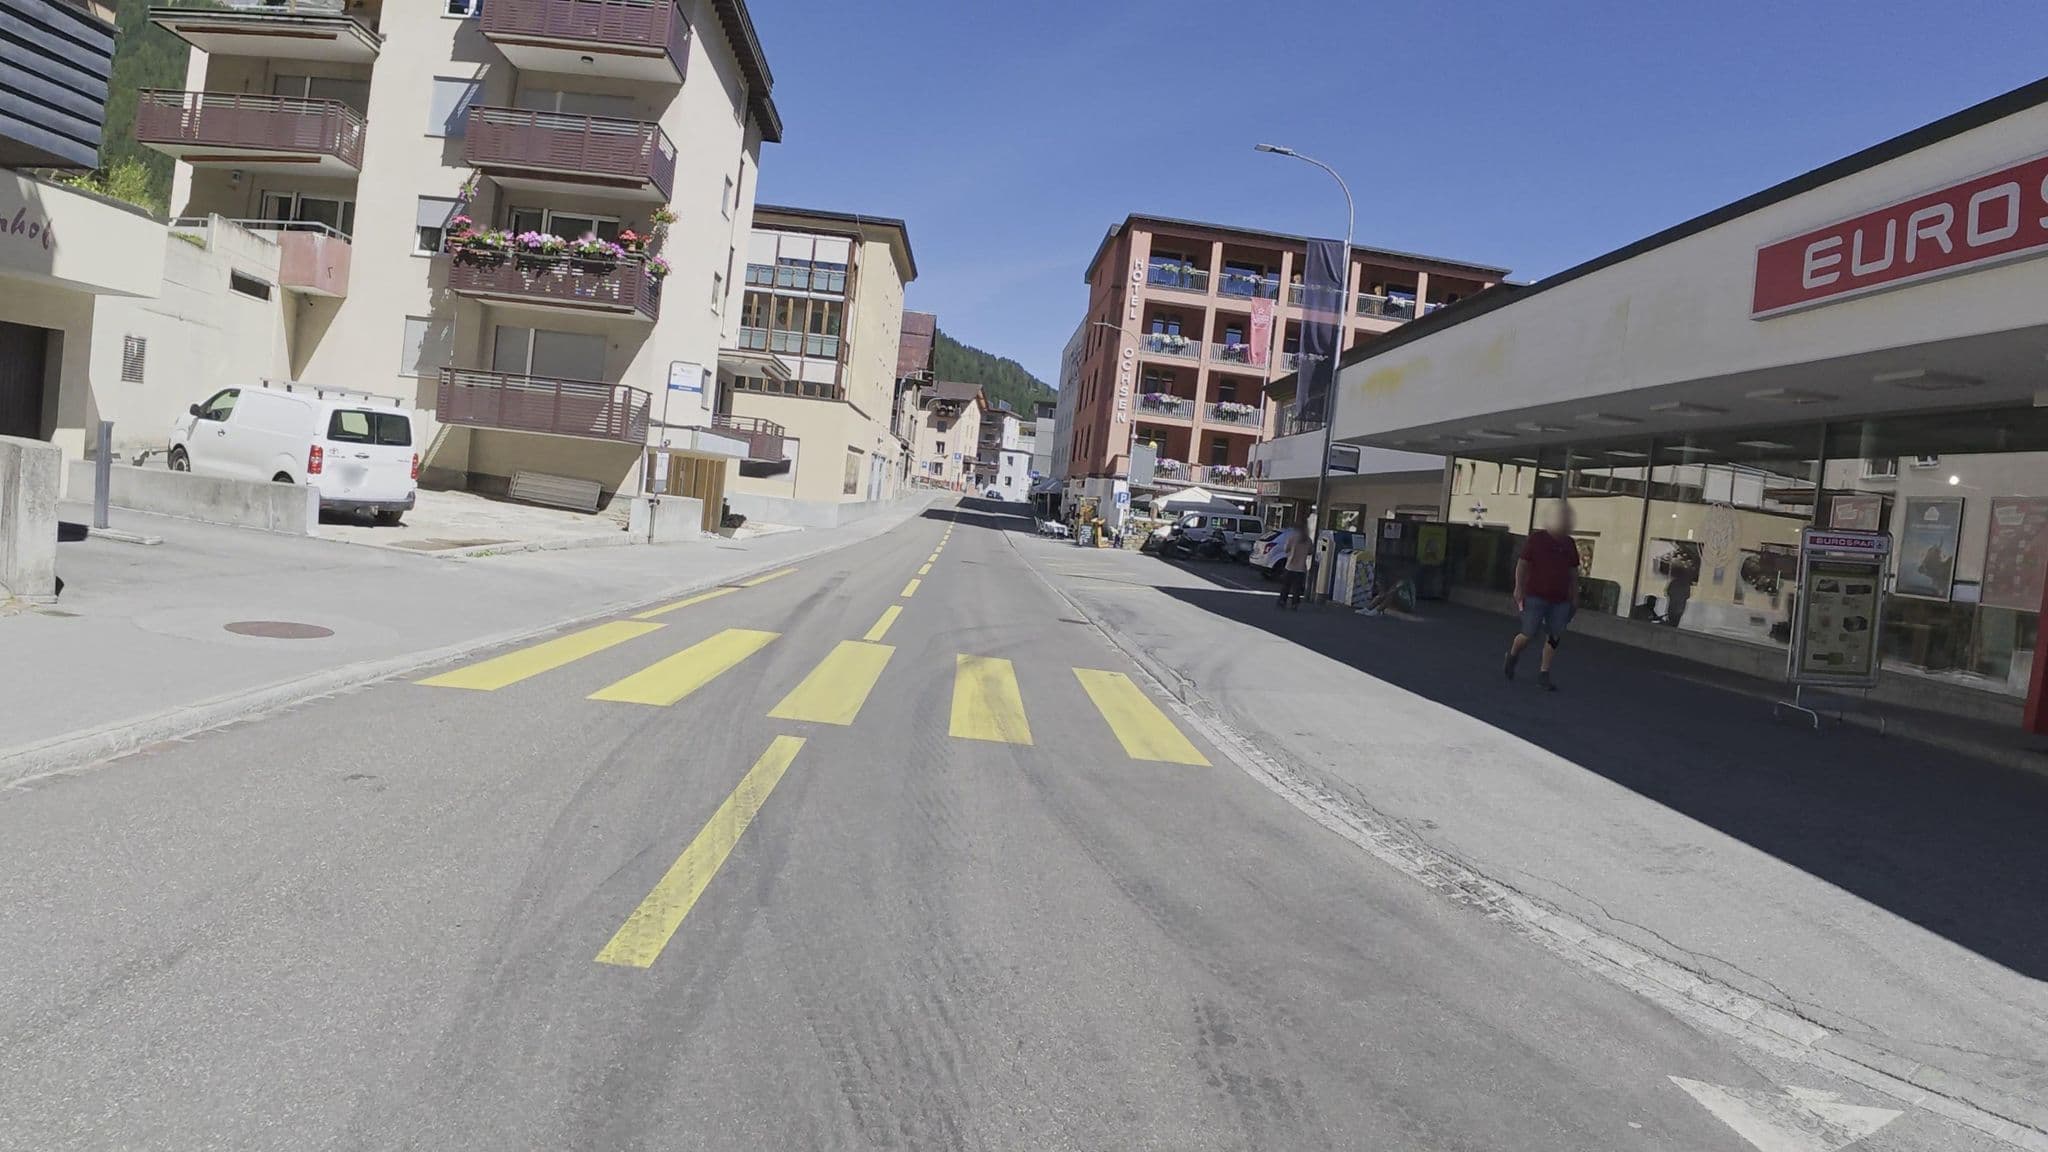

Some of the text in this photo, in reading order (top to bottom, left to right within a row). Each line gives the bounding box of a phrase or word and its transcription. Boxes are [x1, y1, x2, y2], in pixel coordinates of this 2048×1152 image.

[1802, 175, 2048, 290] EURO
[1117, 258, 1143, 423] HOTEL OCHSEN
